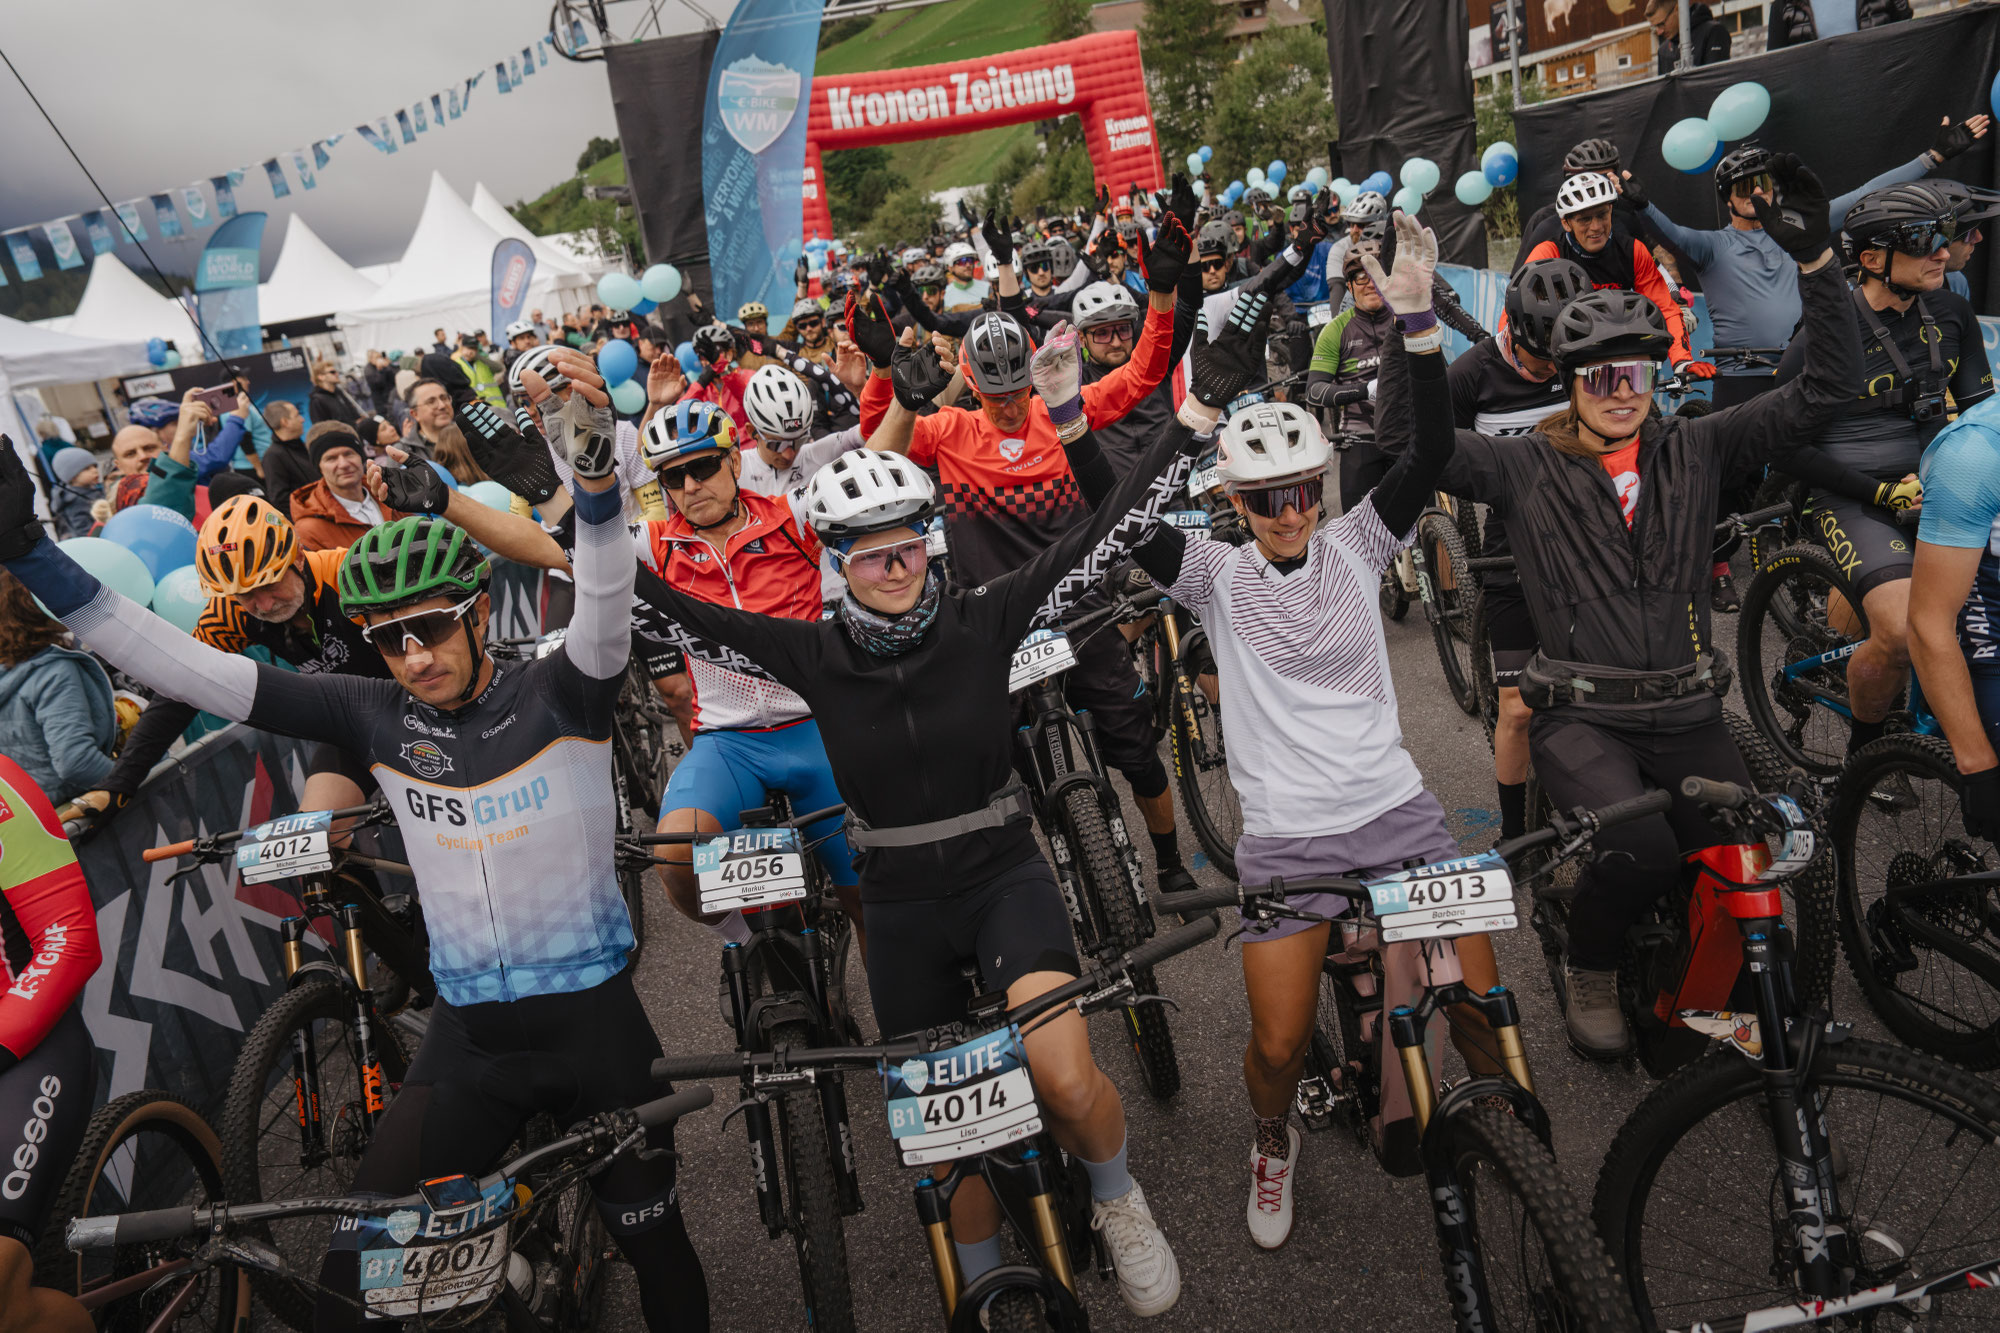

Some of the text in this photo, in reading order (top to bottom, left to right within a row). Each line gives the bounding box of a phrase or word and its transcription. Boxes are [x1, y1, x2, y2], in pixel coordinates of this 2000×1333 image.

[827, 63, 1076, 130] Kronen Zeitung
[733, 111, 778, 132] WM
[1105, 114, 1148, 136] Kronen
[1107, 130, 1152, 152] Zeitung
[207, 263, 254, 276] WORLD
[502, 263, 523, 302] ABUS
[990, 322, 1001, 338] FOX
[1238, 395, 1258, 408] ELITE
[1178, 514, 1207, 527] ELITE
[1766, 556, 1801, 574] MAXXIS
[477, 686, 494, 705] GFS
[481, 713, 518, 740] GSPORT
[413, 748, 426, 757] GFS
[1047, 726, 1067, 775] BIKELOUNG
[406, 775, 551, 827] GFS Grup
[273, 816, 319, 837] ELITE
[436, 825, 529, 852] Cycling Team
[240, 835, 312, 863] B1 4012
[733, 832, 783, 854] ELITE
[696, 851, 784, 883] B1 4056
[1415, 858, 1481, 877] ELITE
[741, 884, 765, 894] Markus
[1376, 874, 1486, 905] B1 4013
[1432, 909, 1466, 919] Barbara
[934, 1040, 1002, 1087] ELITE
[362, 1061, 384, 1114] FOX
[892, 1080, 1007, 1129] B1 4014
[2, 1074, 62, 1200] assos
[960, 1127, 978, 1138] Lisa
[424, 1193, 497, 1238] ELITE
[621, 1201, 665, 1226] GFS
[1792, 1185, 1830, 1265] FOX
[365, 1232, 496, 1279] B1 4007
